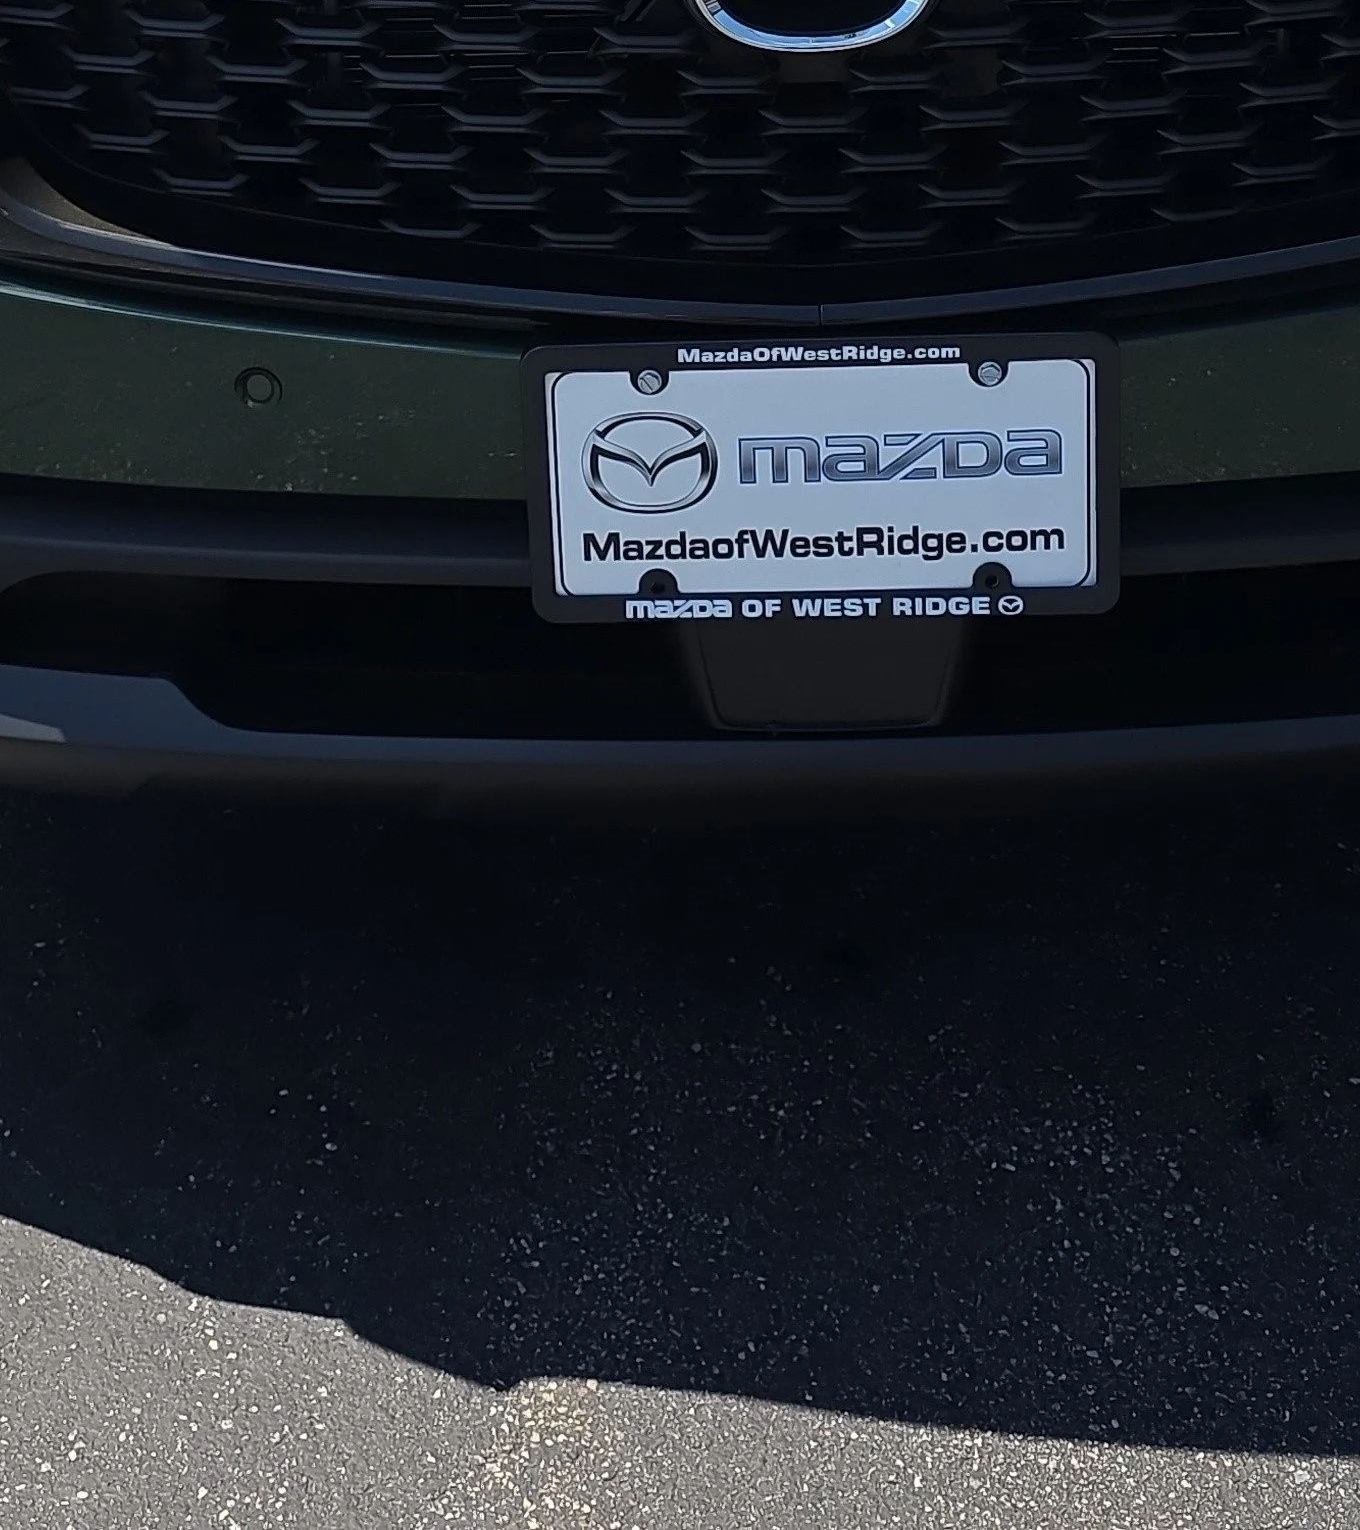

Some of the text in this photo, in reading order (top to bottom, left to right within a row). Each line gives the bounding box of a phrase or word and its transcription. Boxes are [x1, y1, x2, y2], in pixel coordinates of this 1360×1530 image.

[677, 343, 961, 365] MazdaOfWestRidge.com
[738, 427, 1064, 485] mazda
[582, 525, 1066, 563] MazdaofWestRidge.com
[625, 596, 991, 620] mazda OF WEST RIDGE
